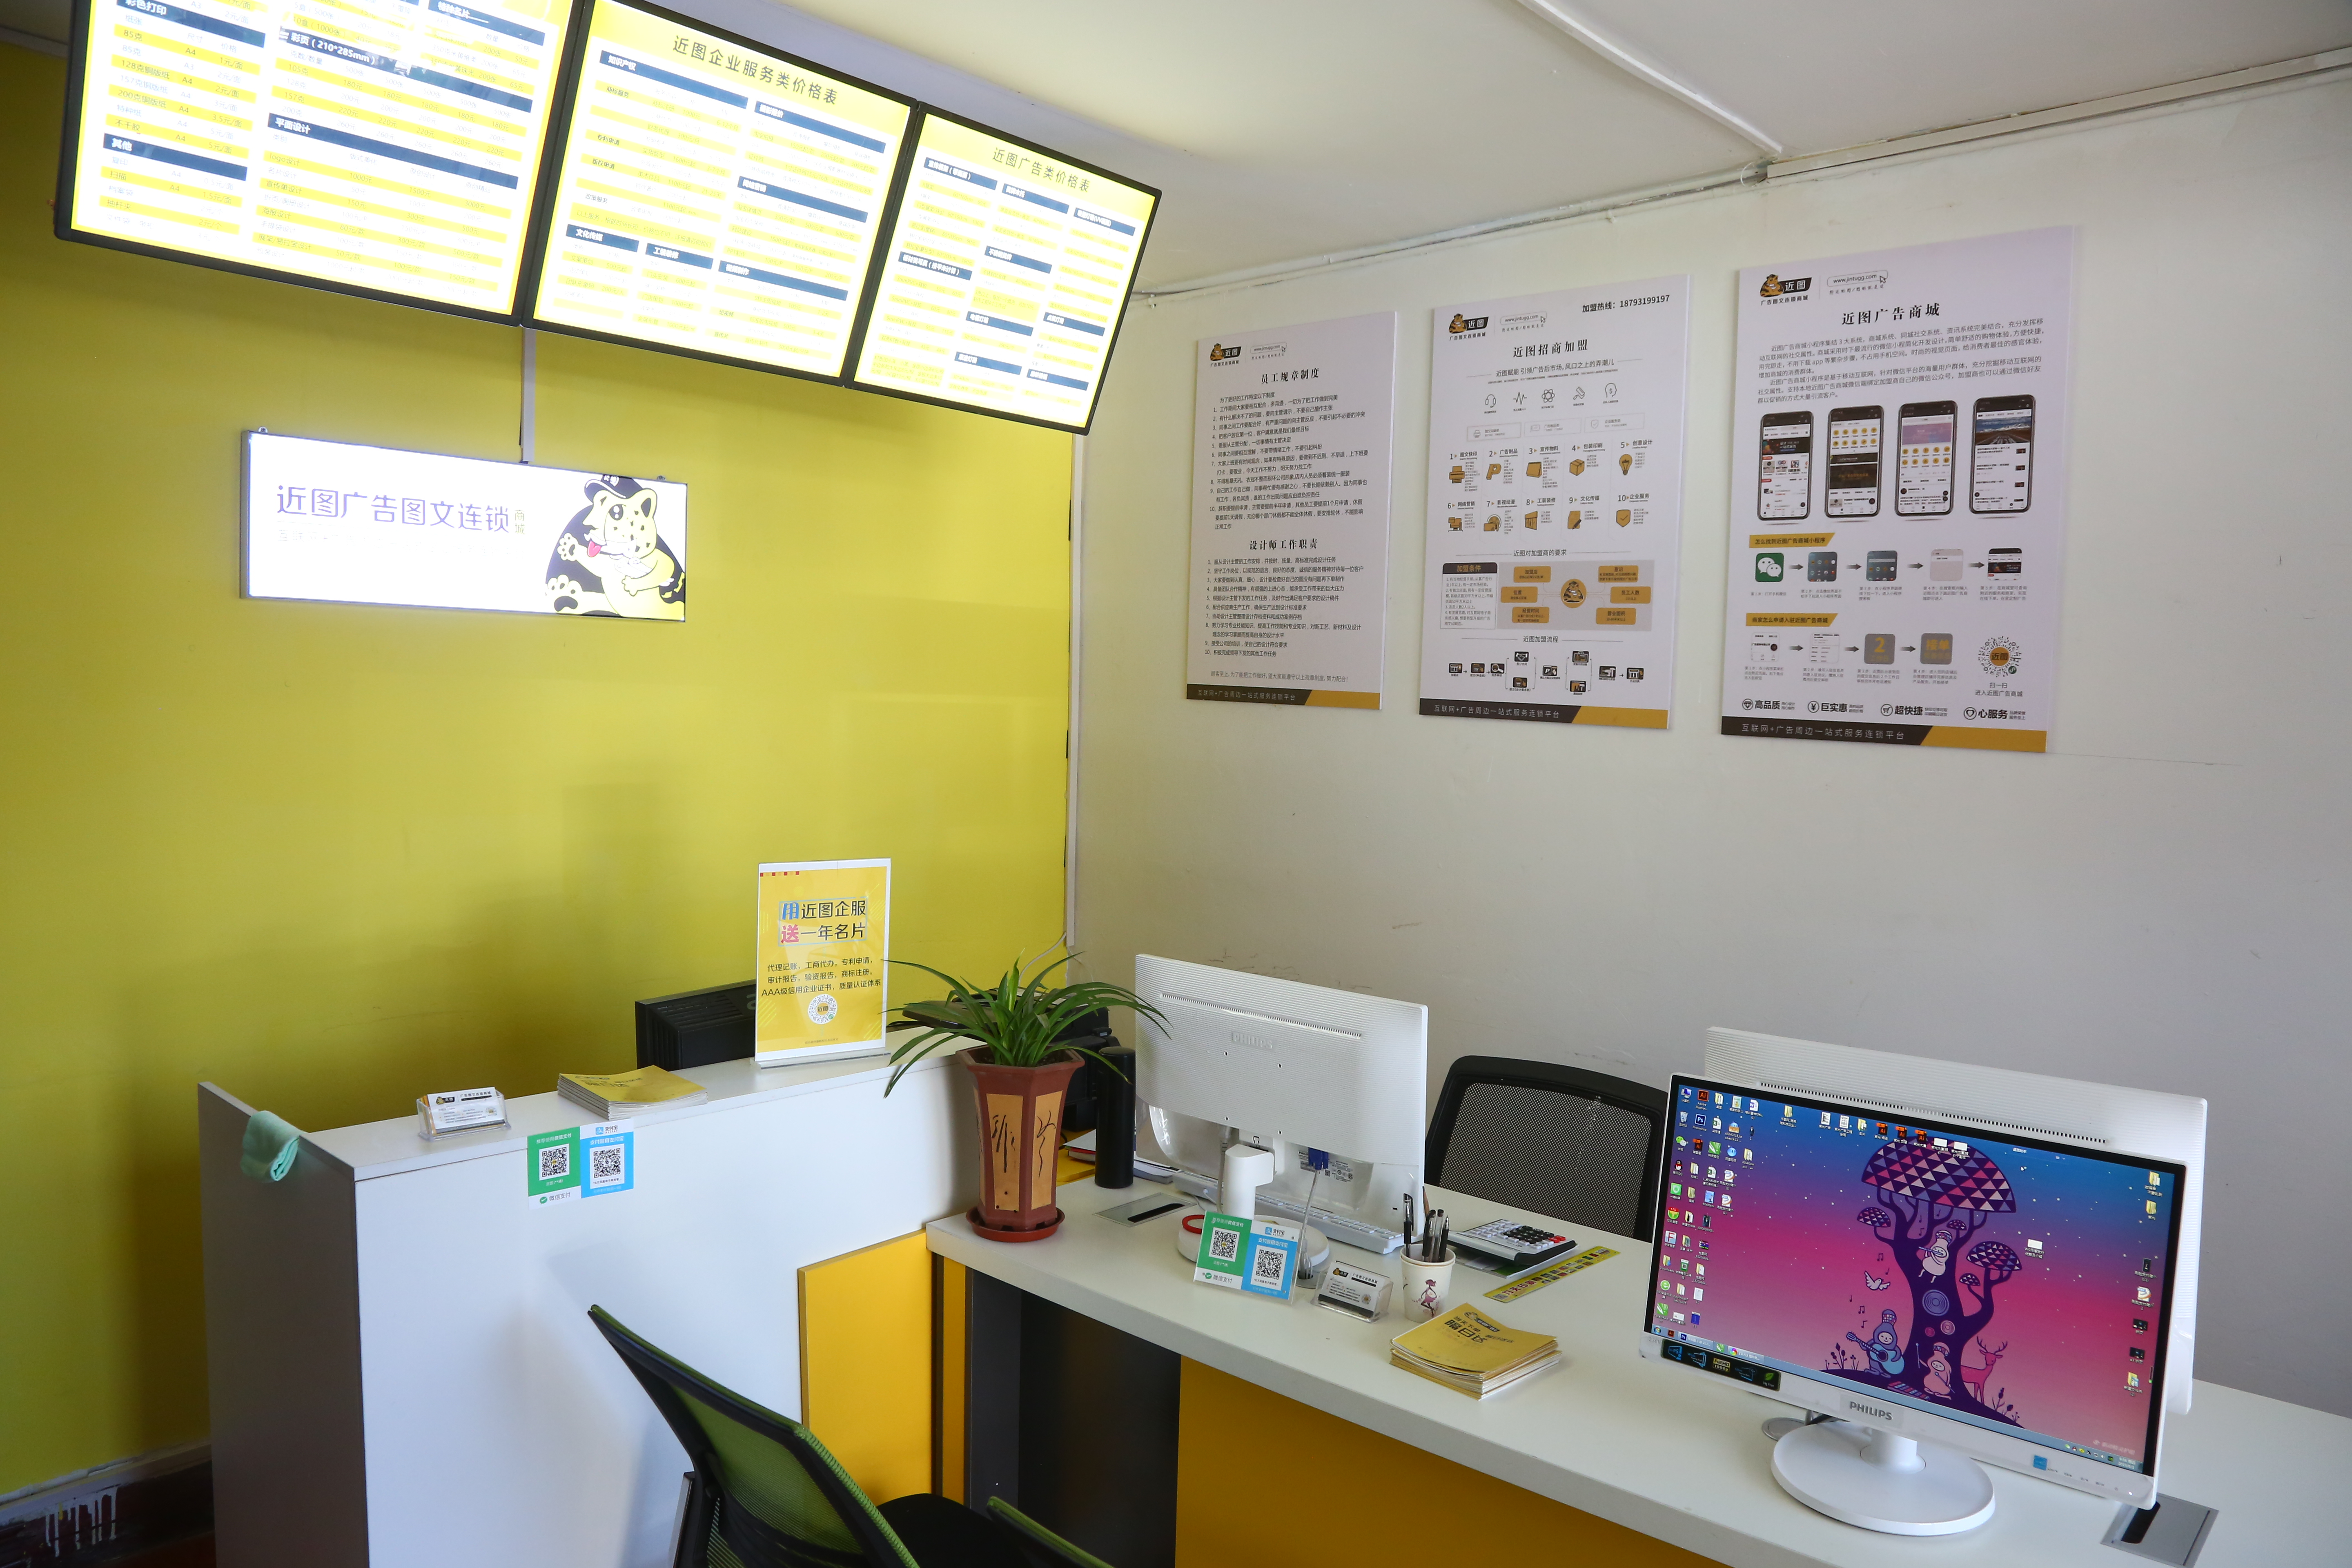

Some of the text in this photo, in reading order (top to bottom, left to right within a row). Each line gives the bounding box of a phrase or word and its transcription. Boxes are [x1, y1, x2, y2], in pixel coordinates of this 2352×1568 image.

[124, 29, 143, 41] 85克
[220, 57, 243, 70] 1元/面
[187, 33, 203, 42] 尺寸
[221, 42, 237, 53] 价格
[122, 44, 141, 56] 85克
[218, 71, 241, 84] 2元/面
[673, 35, 837, 105] 近图企业服务类价格表
[122, 60, 169, 79] 128克铜版纸
[216, 86, 239, 98] 2元/面
[289, 64, 402, 101] 105克 180元 180元
[118, 89, 166, 108] 200克铜版纸
[606, 86, 629, 98] 商标服务
[215, 100, 237, 112] 3元/面
[284, 92, 397, 128] 157克 220元 220元
[275, 117, 310, 134] 平面设计
[115, 119, 140, 131] 不干胶
[209, 142, 232, 154] 5元/面
[597, 134, 620, 146] 专利申请
[112, 138, 132, 151] 其他
[592, 158, 615, 170] 版权申请
[992, 147, 1090, 192] 近图广告类价格表
[110, 170, 127, 180] 扫描
[269, 153, 431, 198] logo设计 1000元 1500元
[266, 180, 366, 209] 宣传单设计 150元
[262, 207, 291, 220] 海报设计
[576, 228, 603, 241] 文化传媒
[1833, 274, 1877, 283] www.jintugg.com
[1785, 281, 1806, 292] 近图
[1619, 295, 1670, 308] 18793199197
[1761, 295, 1808, 305] 广告图文连锁商城
[1505, 314, 1538, 323] www.jintugg.com
[1842, 303, 1940, 325] 近图广告商城
[1468, 318, 1484, 328] 近图
[1225, 348, 1238, 356] 近图
[1513, 339, 1588, 358] 近图招商加盟
[1261, 368, 1319, 384] 员工规章制度
[277, 485, 509, 533] 近图广告图文连锁
[1249, 538, 1318, 550] 设计师工作职责
[1874, 637, 1885, 653] 2
[1926, 640, 1950, 650] 接单
[1992, 653, 2008, 661] 近图
[1198, 690, 1296, 701] 互联网+广告周边一站式服务连锁平台
[1434, 705, 1559, 718] 互联网+广告周边一站式服务连锁平台
[1755, 700, 1780, 710] 高品质
[1821, 703, 1847, 712] 巨实惠
[1895, 706, 1922, 715] 超快捷
[1978, 710, 2008, 719] 心服务
[1742, 724, 1904, 739] 互联网+广告周边一站式服务连锁平台
[782, 900, 866, 920] 用近图企服
[780, 923, 865, 944] 送一年名片
[537, 1133, 572, 1144] 推荐使用微信支付
[549, 1192, 570, 1201] 微信支付
[1213, 1274, 1232, 1283] 微信支付
[1850, 1401, 1893, 1420] PHILIPS
